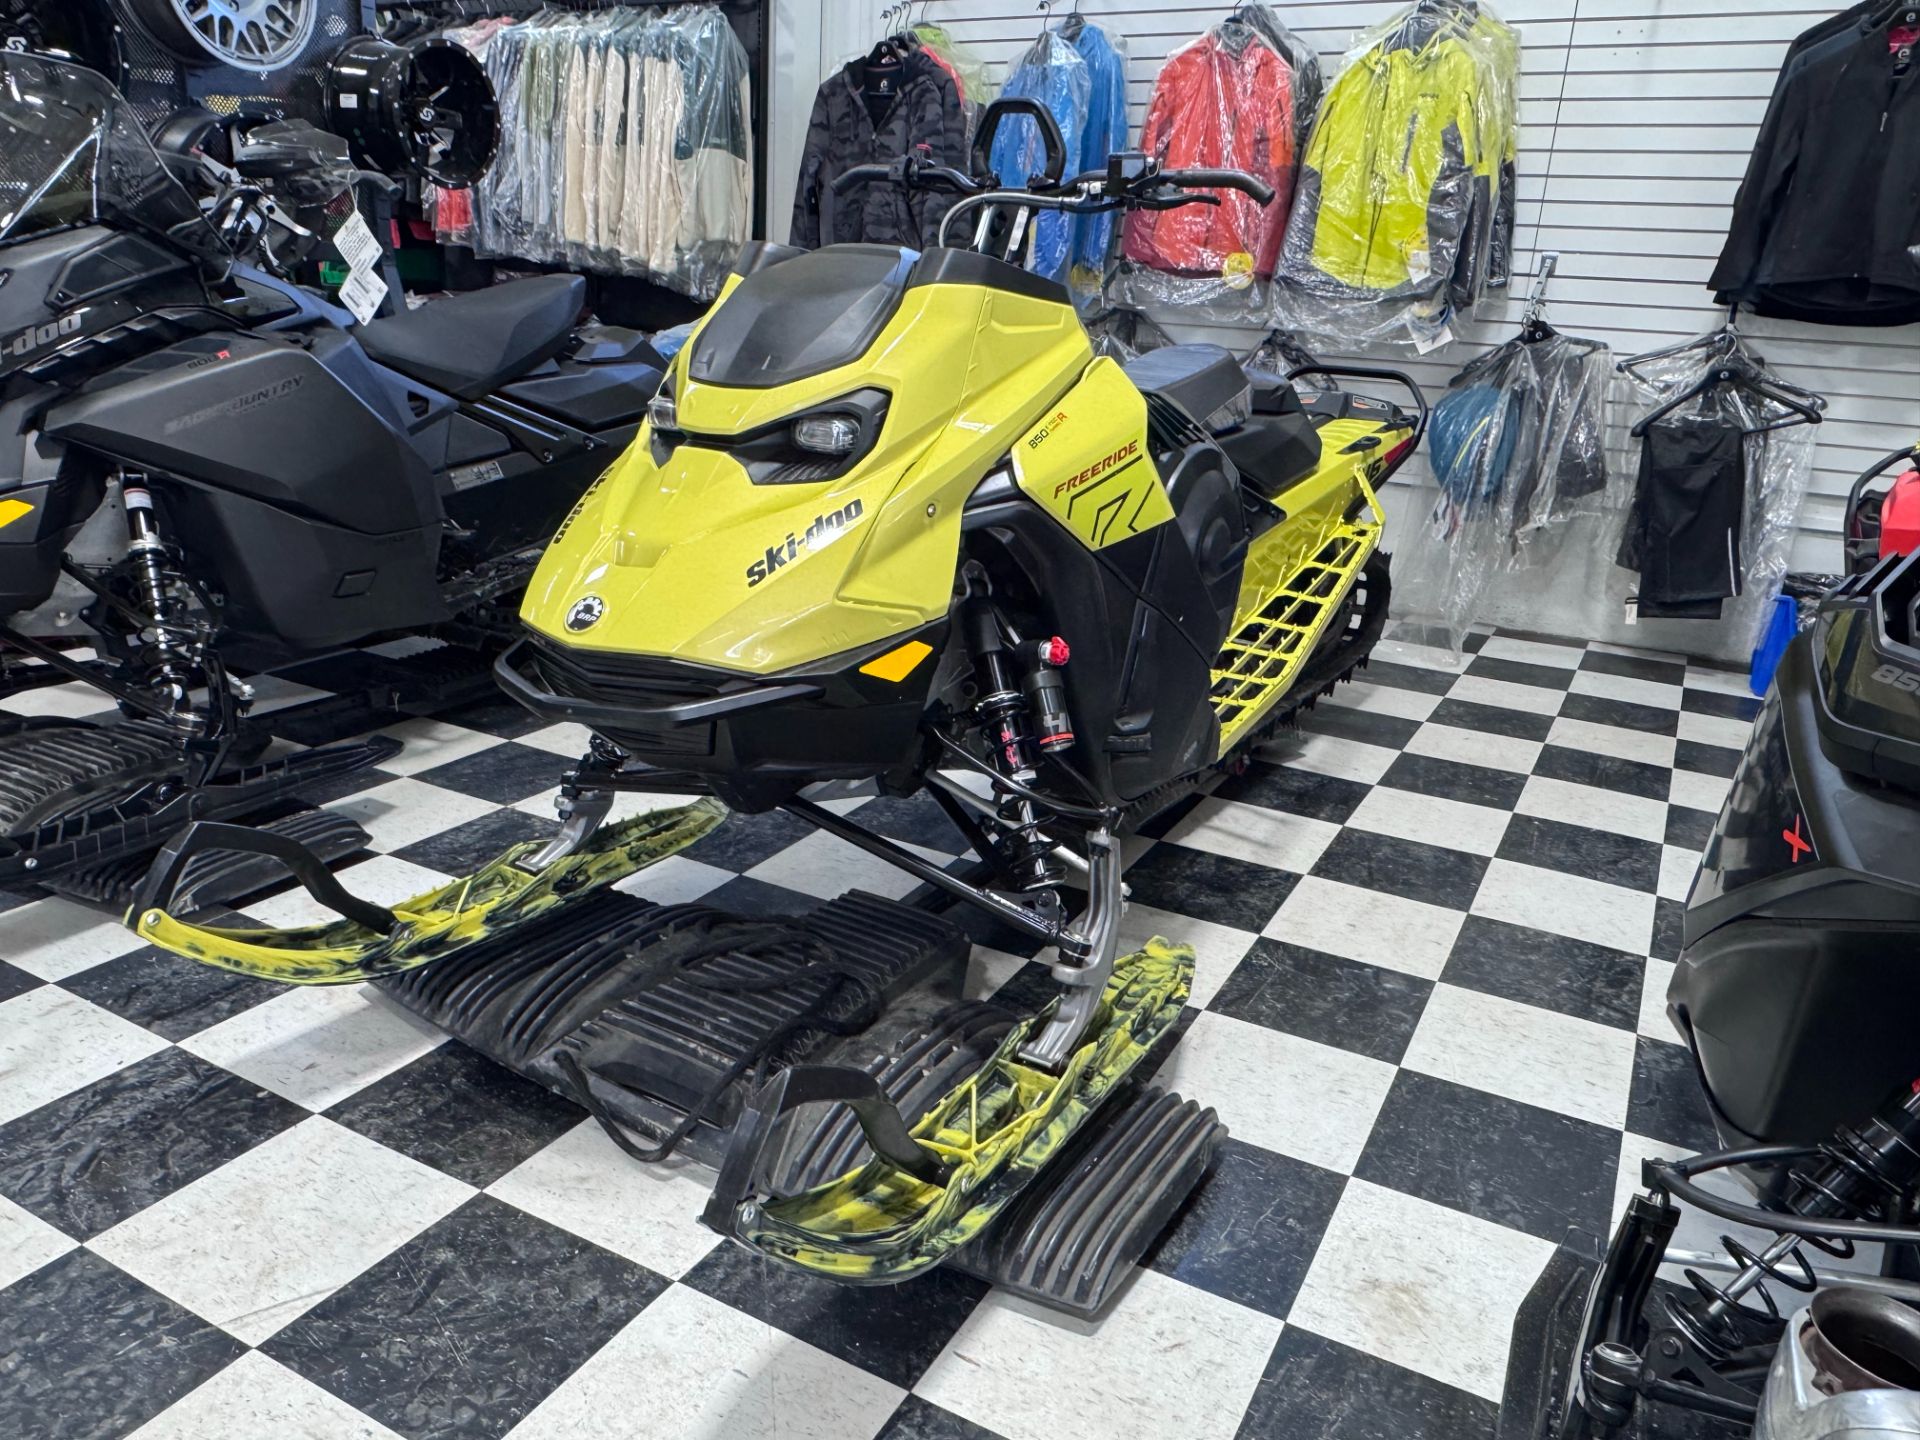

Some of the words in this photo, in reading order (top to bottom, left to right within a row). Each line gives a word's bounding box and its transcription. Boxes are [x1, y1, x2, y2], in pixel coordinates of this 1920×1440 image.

[0, 313, 82, 365] -doo
[1028, 428, 1050, 449] 850
[1054, 439, 1138, 499] FREERIDE
[746, 498, 863, 588] ski-doo
[576, 612, 598, 622] BRP
[1871, 664, 1920, 696] 85
